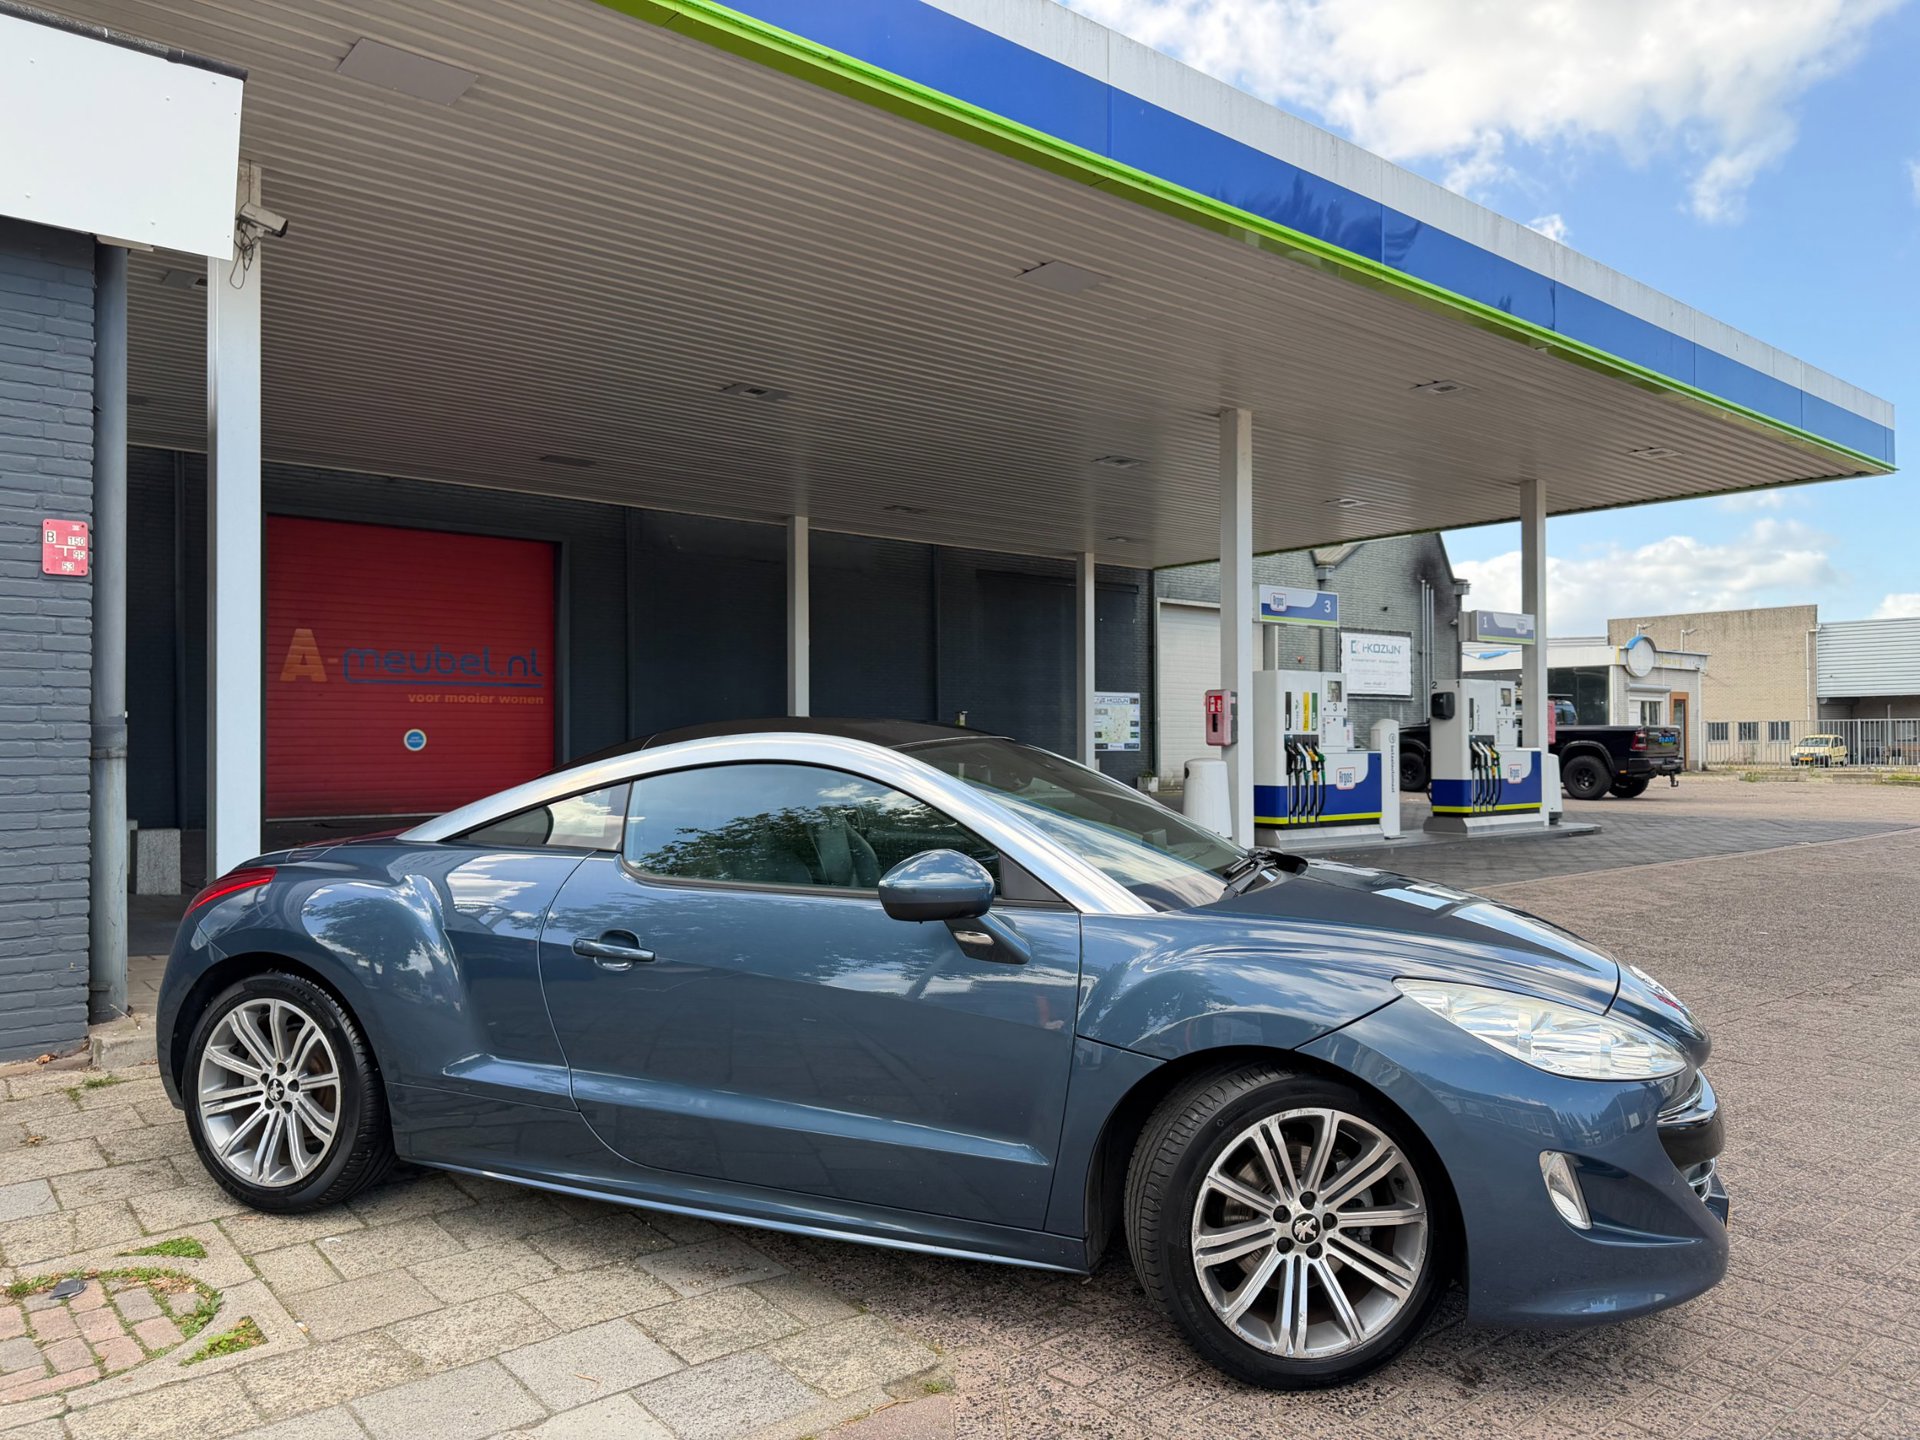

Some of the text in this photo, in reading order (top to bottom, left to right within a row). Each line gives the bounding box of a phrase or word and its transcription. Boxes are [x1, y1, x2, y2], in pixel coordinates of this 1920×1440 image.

[46, 531, 55, 543] B
[69, 537, 85, 546] 150
[1323, 600, 1331, 613] 3
[1482, 616, 1488, 628] 1
[1431, 681, 1438, 689] 2
[1456, 680, 1460, 688] 1
[408, 693, 545, 705] voor mooier wonen
[1332, 703, 1338, 712] 3
[1504, 708, 1509, 716] 1
[1338, 771, 1353, 786] Argos
